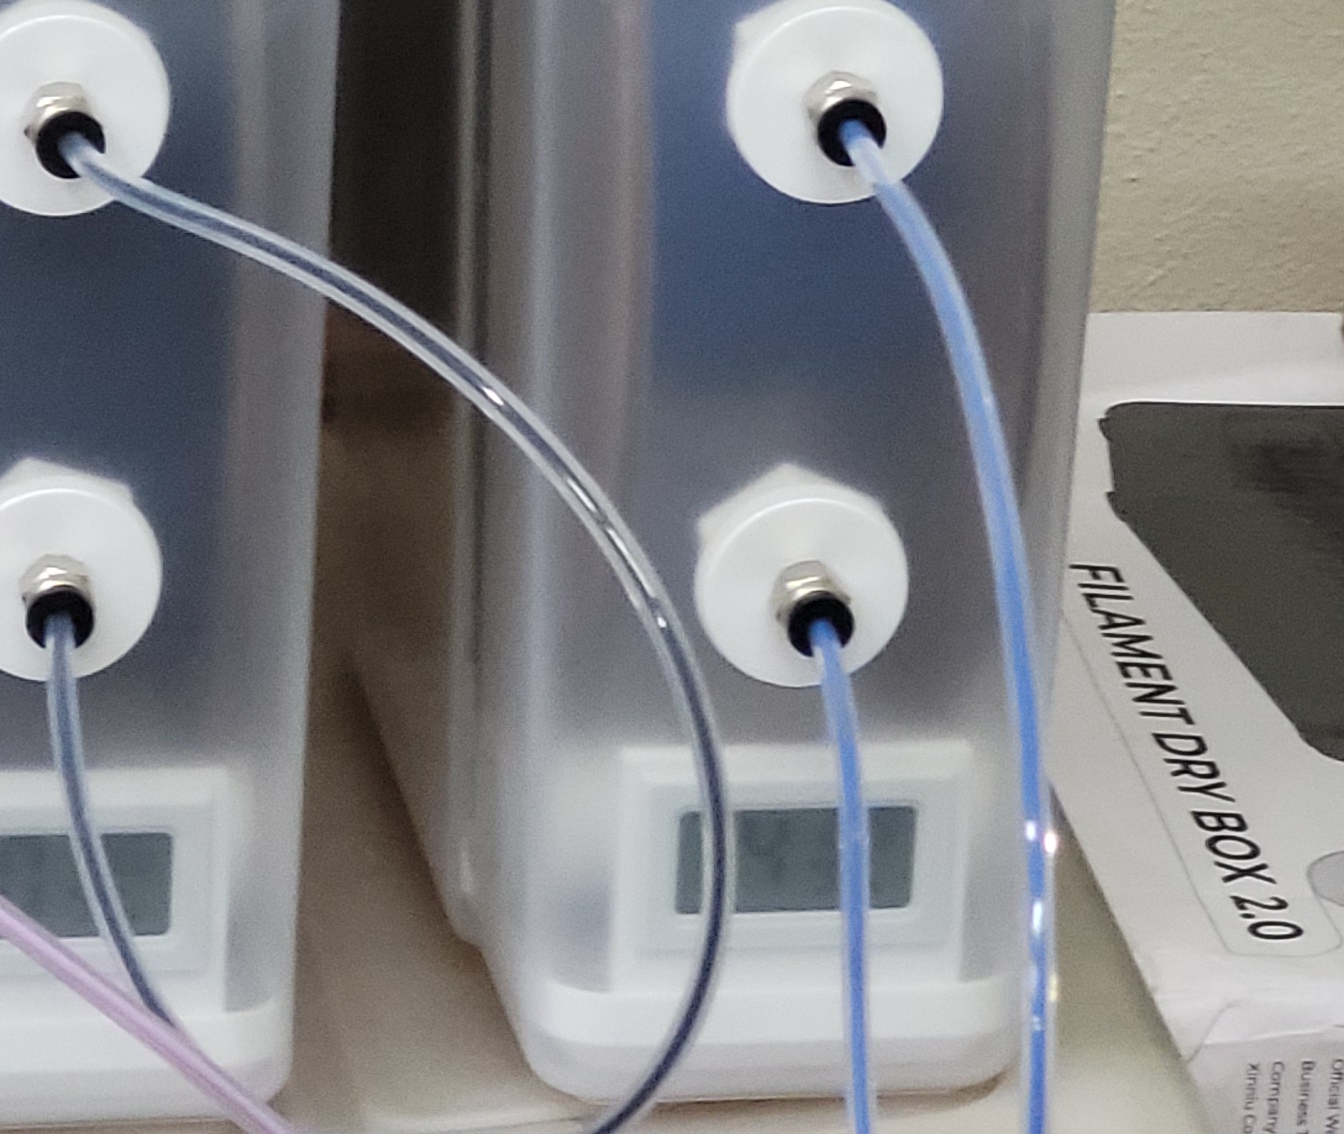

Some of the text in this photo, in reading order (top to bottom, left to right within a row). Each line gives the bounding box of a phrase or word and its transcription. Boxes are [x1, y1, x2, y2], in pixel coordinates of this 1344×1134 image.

[1068, 563, 1304, 940] FILAMENT DRY BOX 2.0
[1263, 1061, 1285, 1134] Company
[1296, 1060, 1316, 1126] Business
